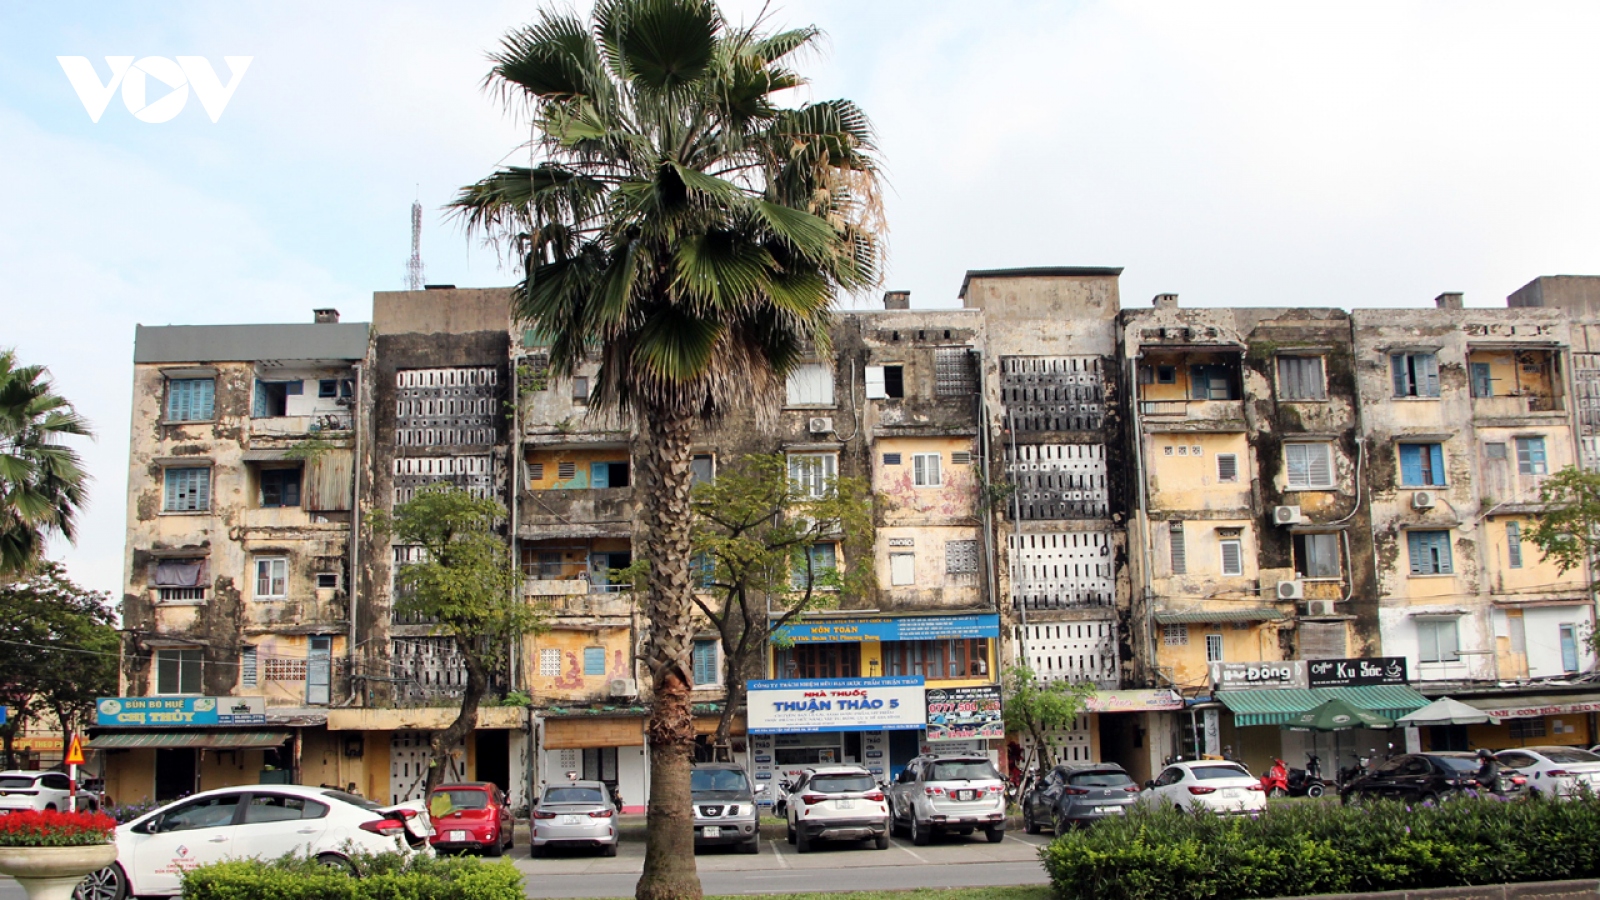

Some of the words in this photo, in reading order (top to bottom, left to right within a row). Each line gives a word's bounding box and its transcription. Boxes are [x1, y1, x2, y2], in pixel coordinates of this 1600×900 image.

[810, 625, 830, 634] MÔN
[834, 624, 858, 634] TOÁN
[1336, 662, 1356, 678] Ku
[804, 690, 827, 698] NHÀ
[830, 688, 868, 697] THUỐC
[126, 699, 146, 708] BÚN
[164, 698, 184, 708] HUẾ
[774, 698, 832, 713] THUẬN
[837, 696, 884, 711] THẢO
[889, 698, 900, 708] 5
[929, 702, 956, 713] 0777
[118, 712, 146, 724] CHỊ
[149, 708, 196, 722] THỦY
